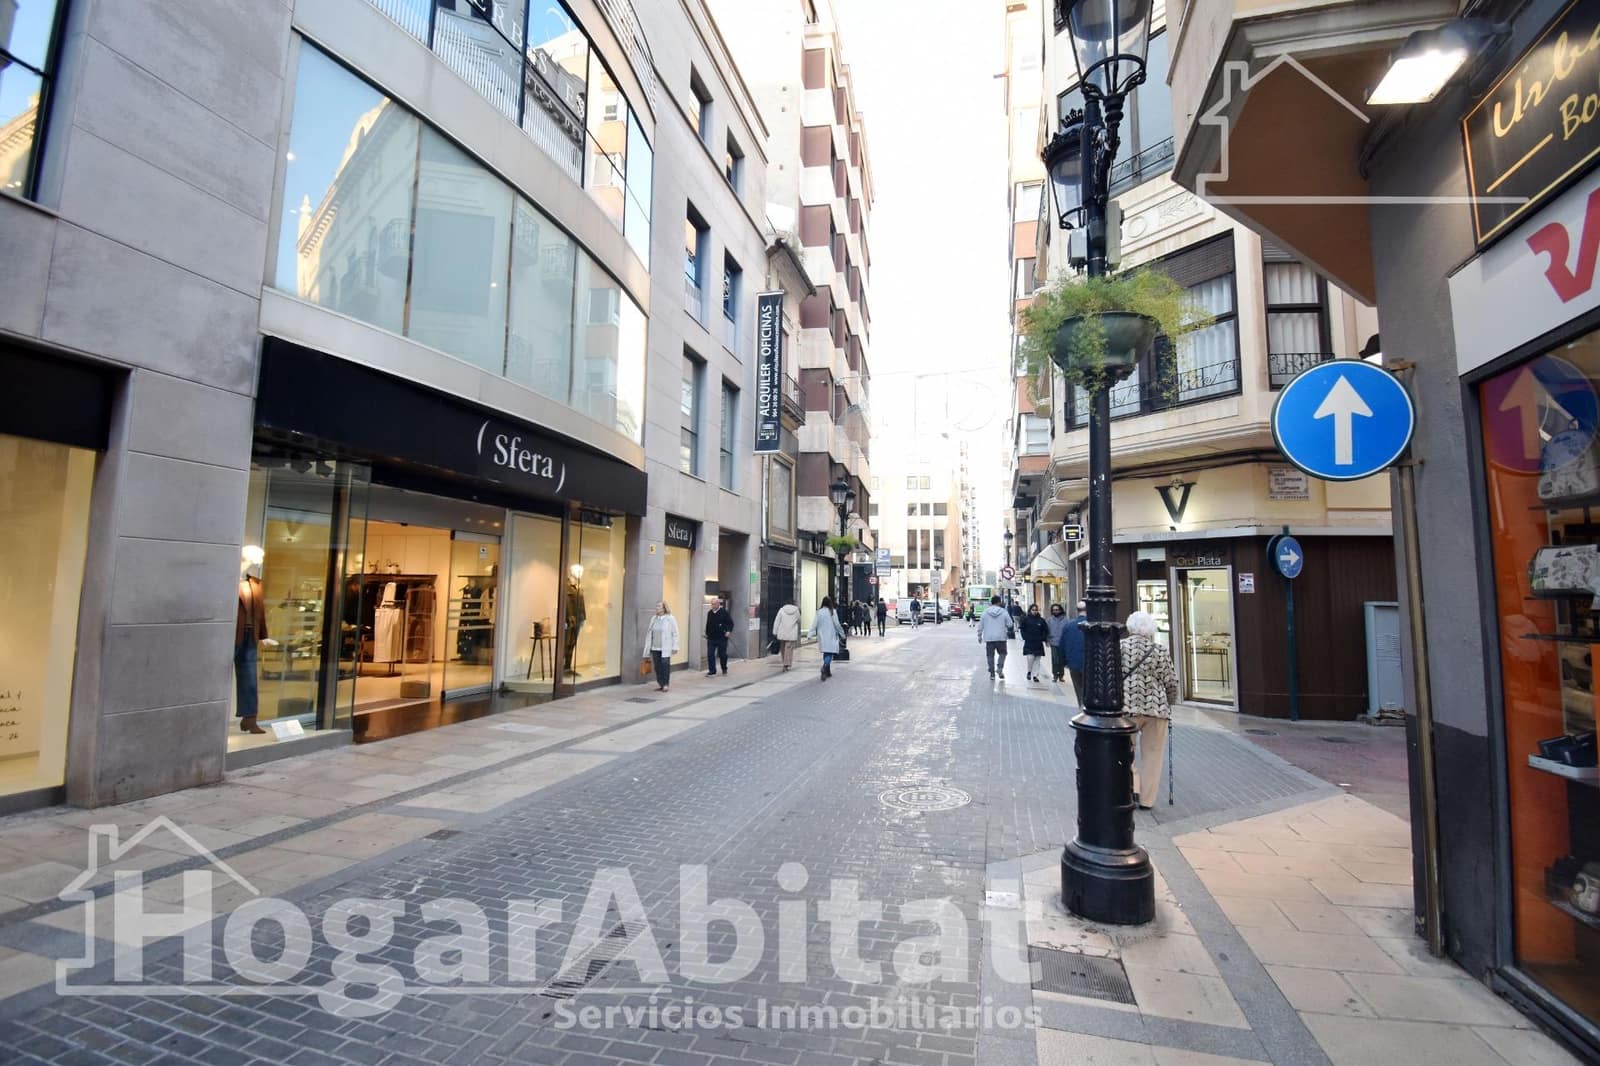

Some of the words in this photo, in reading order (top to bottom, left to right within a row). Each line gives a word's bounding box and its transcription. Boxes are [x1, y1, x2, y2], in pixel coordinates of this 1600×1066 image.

[1560, 93, 1600, 140] Bo
[760, 304, 773, 357] OFICINAS
[759, 363, 771, 417] ALQUILER
[1154, 481, 1198, 524] V
